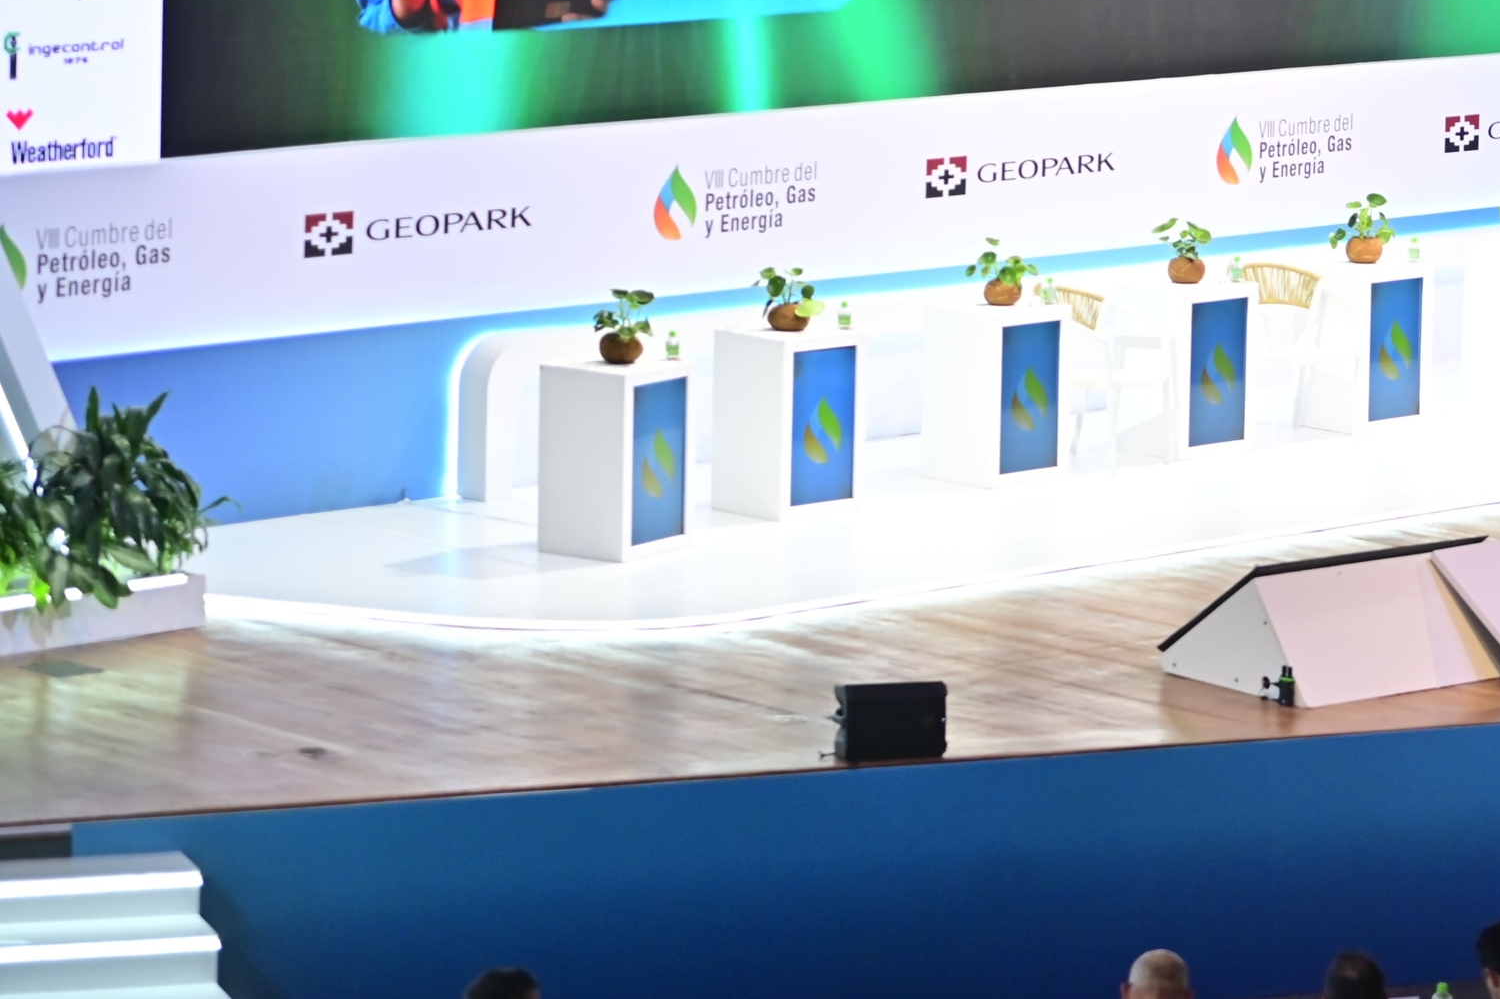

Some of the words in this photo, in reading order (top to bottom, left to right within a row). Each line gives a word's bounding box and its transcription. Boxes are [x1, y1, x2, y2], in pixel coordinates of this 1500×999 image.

[28, 39, 124, 57] ingecontrol
[1258, 118, 1276, 138] VIII
[1279, 116, 1331, 137] Cumbre
[1334, 113, 1354, 132] del
[11, 136, 114, 164] Weatherford
[1259, 135, 1321, 160] Petróleo,
[1328, 135, 1352, 153] Gas
[704, 169, 724, 190] VIII
[727, 165, 790, 189] Cumbre
[794, 161, 818, 183] del
[977, 152, 1115, 184] GEOPARK
[1259, 164, 1267, 183] y
[1273, 156, 1325, 180] Energía
[705, 184, 780, 212] Petróleo,
[786, 184, 816, 205] Gas
[36, 227, 60, 250] VIII
[65, 223, 140, 249] Cumbre
[144, 218, 173, 241] del
[366, 206, 532, 242] GEOPARK
[705, 218, 714, 238] y
[721, 209, 783, 233] Energía
[37, 246, 127, 275] Petróleo,
[135, 244, 171, 267] Gas
[37, 284, 47, 303] y
[56, 273, 132, 299] Energía
